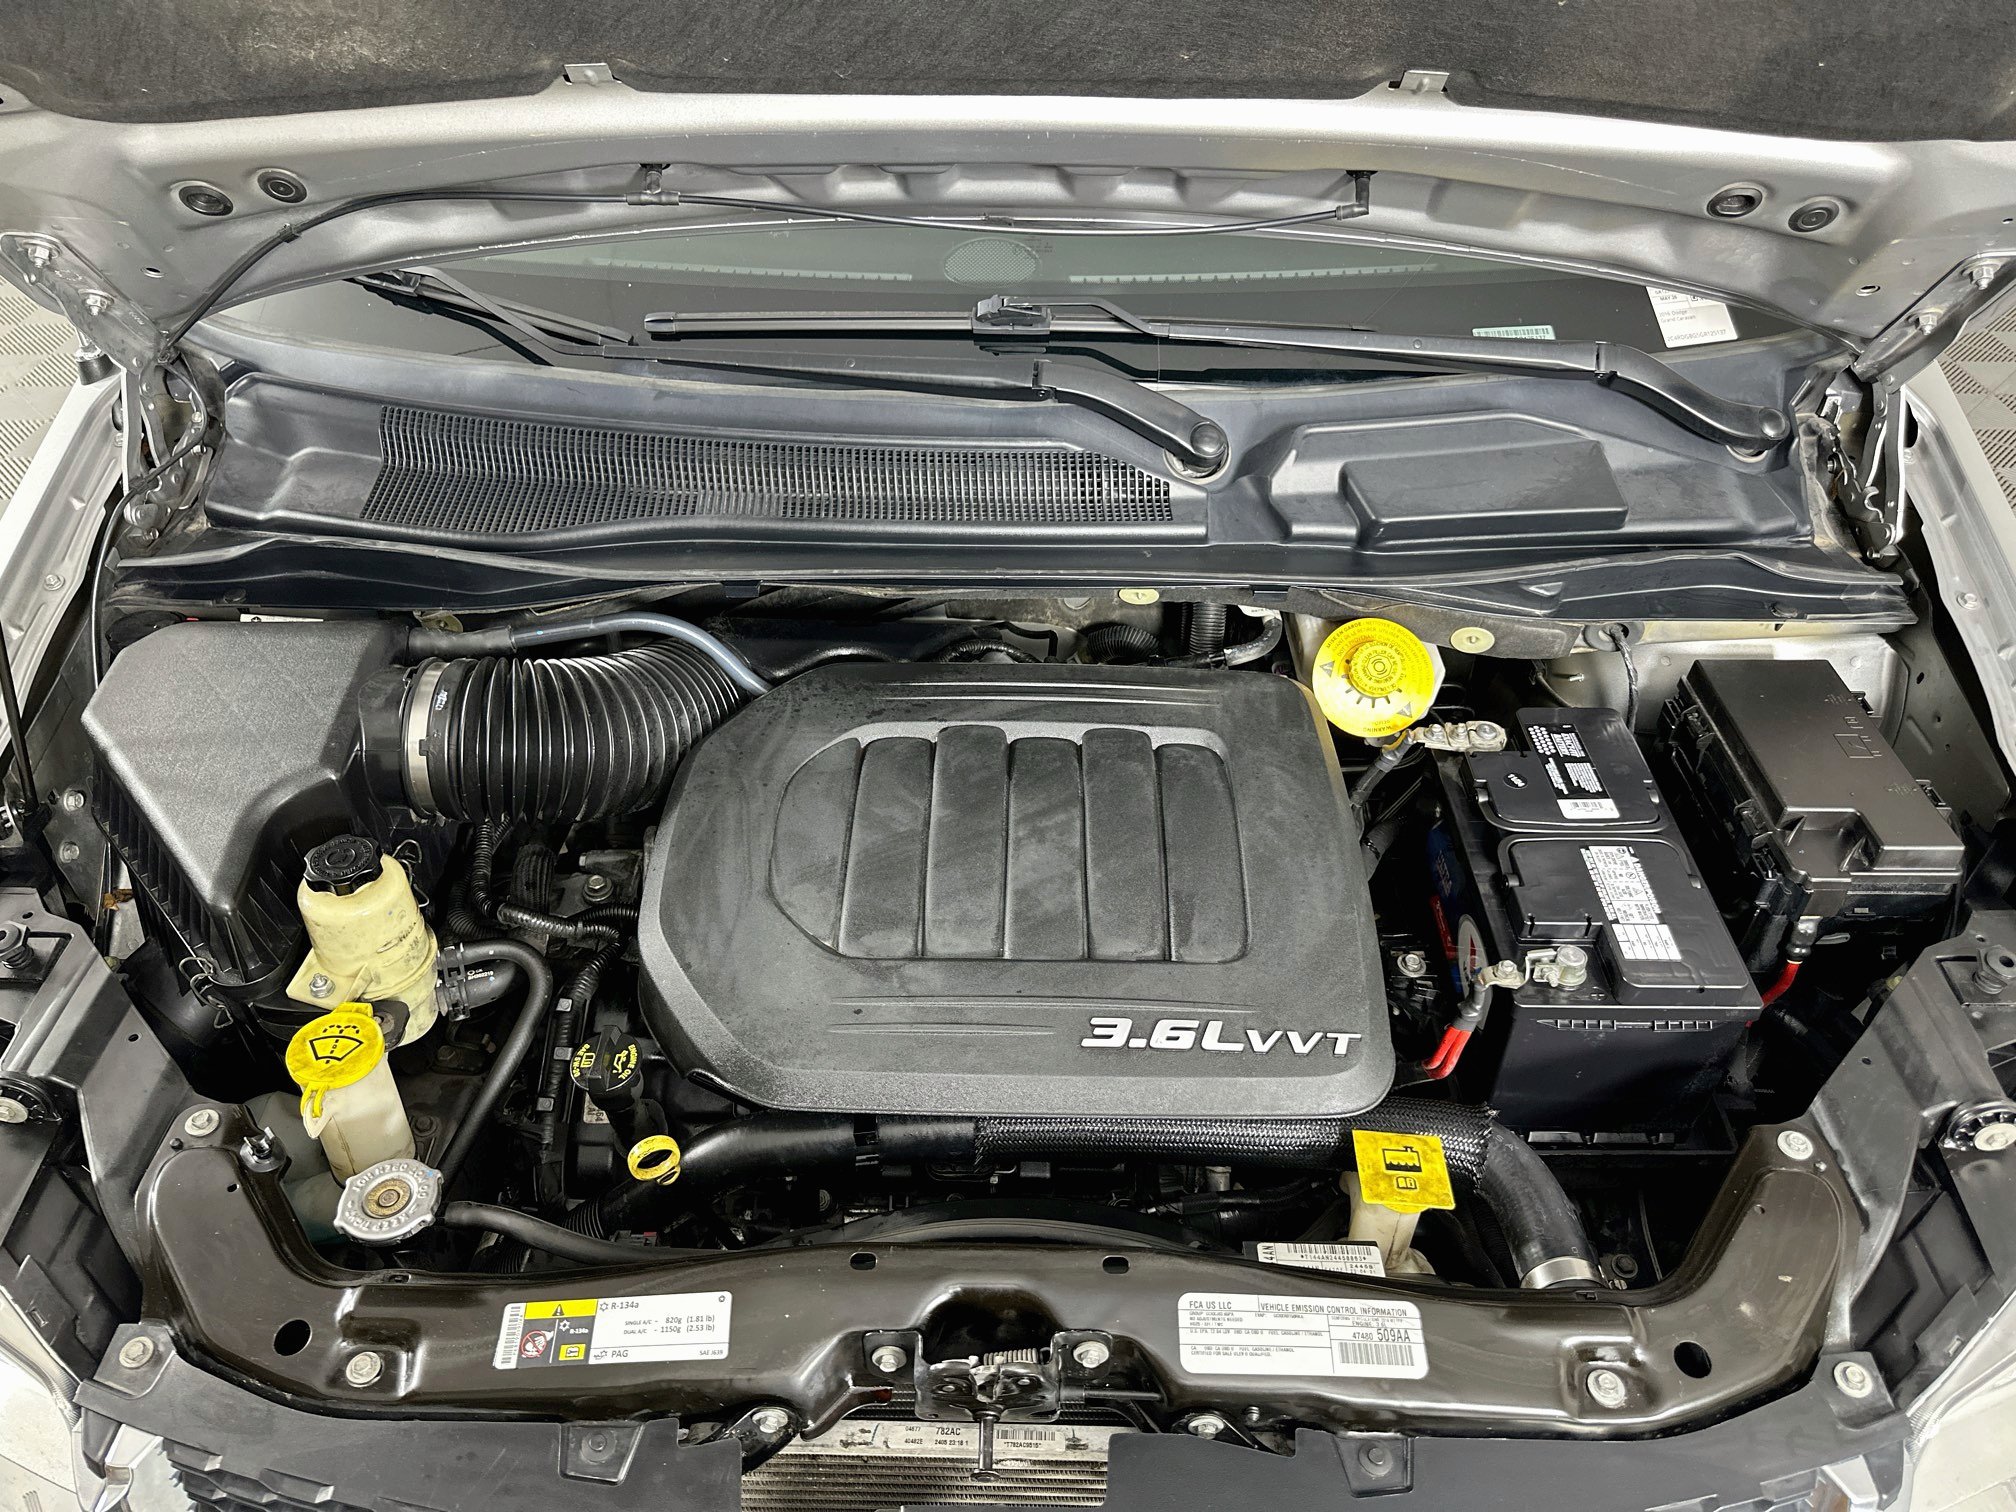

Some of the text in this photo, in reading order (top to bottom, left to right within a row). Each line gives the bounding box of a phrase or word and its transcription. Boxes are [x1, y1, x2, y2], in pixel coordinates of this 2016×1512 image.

[577, 1043, 591, 1057] SAE
[617, 1043, 638, 1080] ENGINE OIL
[1262, 1245, 1275, 1263] 4AN
[611, 1301, 639, 1310] R-134a
[1189, 1301, 1232, 1310] FCA US LLC
[1260, 1302, 1407, 1317] VEHICLE EMISSION CONTROL INFORMATION
[665, 1317, 682, 1325] 820g
[686, 1315, 704, 1323] (1.81
[661, 1326, 681, 1334] 1150g
[686, 1324, 704, 1332] (2.53
[1376, 1328, 1411, 1342] 509AA
[611, 1350, 629, 1358] PAG
[935, 1427, 961, 1436] 782AC
